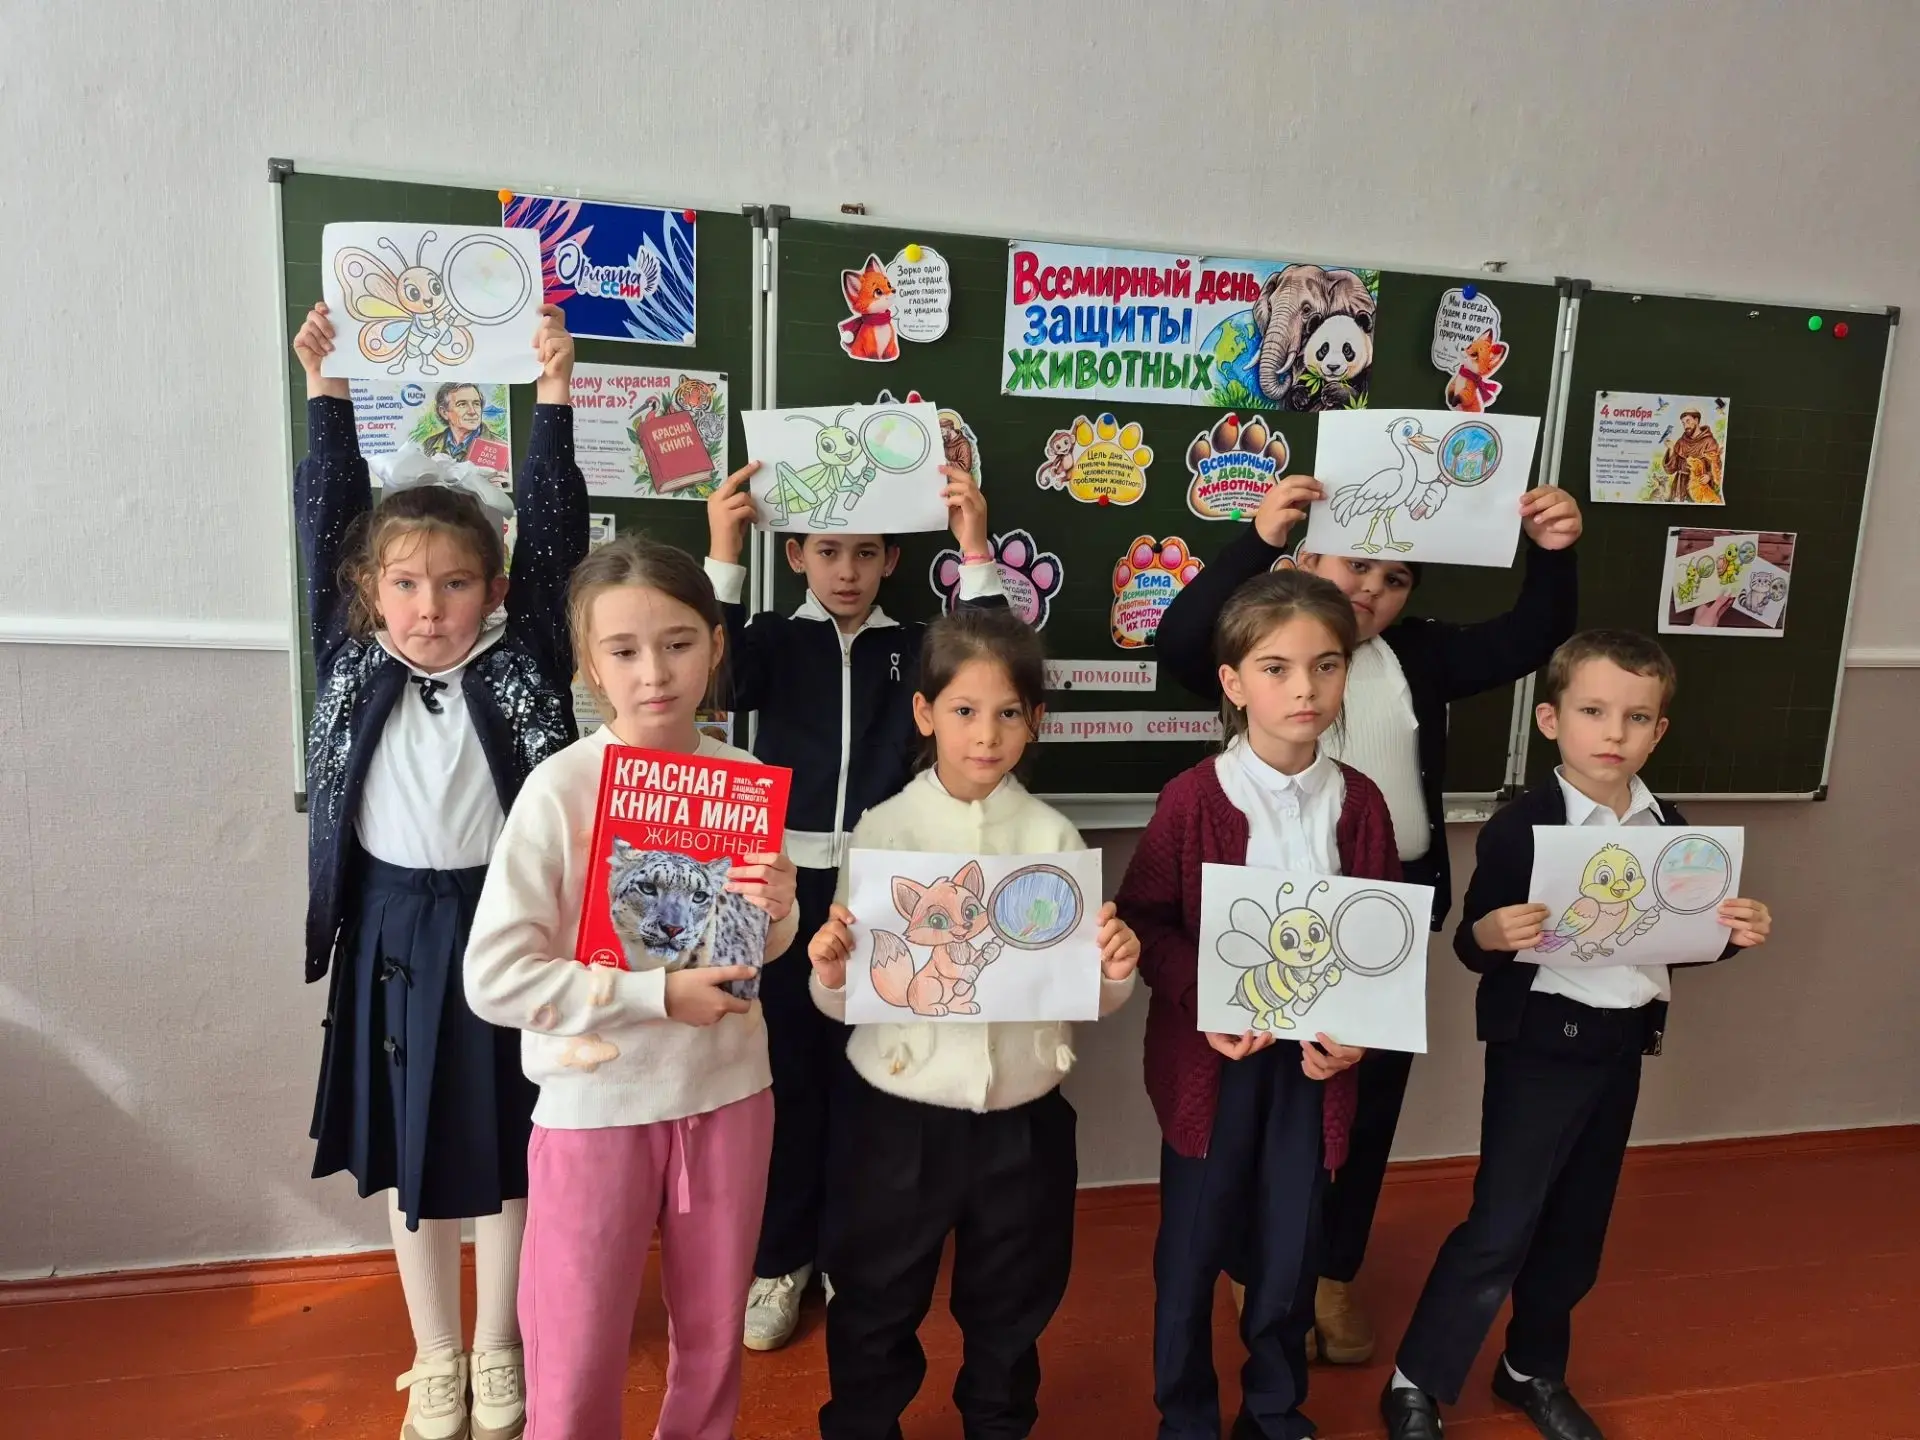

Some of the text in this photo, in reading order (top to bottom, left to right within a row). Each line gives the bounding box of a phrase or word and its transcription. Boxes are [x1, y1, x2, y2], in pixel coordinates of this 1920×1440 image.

[898, 265, 922, 277] Зорко
[898, 276, 943, 286] лишь сердце
[1013, 251, 1261, 305] Всемирный день
[899, 289, 920, 298] Самого
[1448, 295, 1488, 313] Мы всегда
[915, 308, 943, 316] увидишь
[1441, 305, 1460, 318] будем
[1469, 314, 1494, 325] ответе
[1023, 305, 1193, 348] защиты
[1443, 319, 1482, 333] за тех, кого
[1440, 329, 1475, 341] приручили
[1006, 349, 1214, 391] животных
[606, 376, 670, 391] «красная
[407, 392, 426, 400] IUCN
[1600, 404, 1653, 421] 4 октября
[367, 422, 397, 431] Скотт,
[652, 422, 692, 442] КРАСНАЯ
[484, 446, 497, 454] RED
[659, 437, 694, 454] КНИГА
[480, 451, 497, 460] DATA
[1087, 450, 1107, 460] Цель
[1109, 452, 1123, 460] дня
[477, 457, 496, 466] BOOK
[1077, 461, 1135, 471] привлечь внимание
[1082, 469, 1126, 477] человечества
[1073, 475, 1142, 488] проблемам животного
[1093, 486, 1117, 497] мира
[1134, 573, 1171, 589] Тема
[1122, 590, 1168, 602] Всемирного
[1157, 597, 1172, 606] 202
[1126, 621, 1138, 632] их
[1072, 670, 1152, 685] помощь
[1070, 721, 1134, 739] прямо
[1146, 716, 1218, 734] сейчас!
[613, 757, 728, 798] КРАСНАЯ
[609, 789, 769, 835] КНИГА МИРА
[643, 826, 767, 856] ЖИВОТНЫЕ
